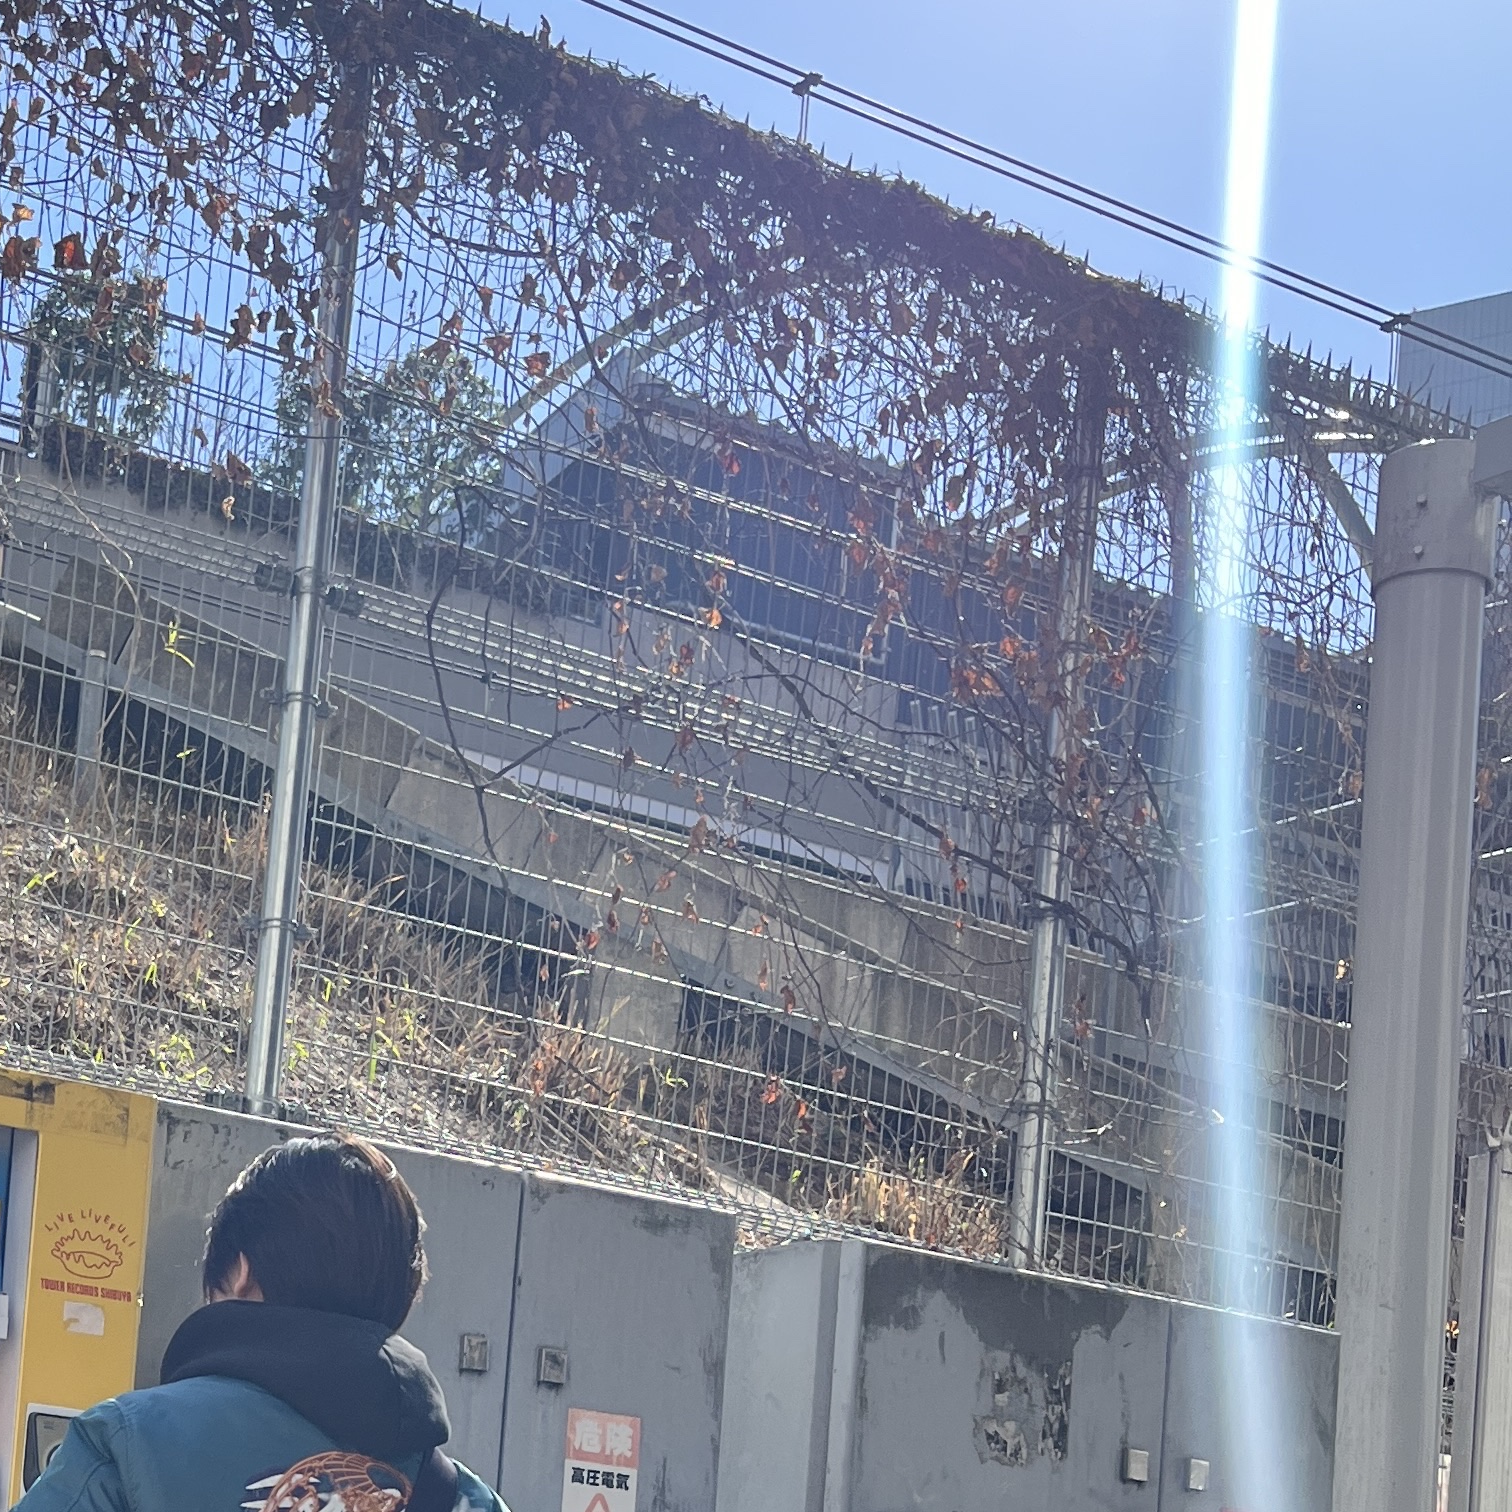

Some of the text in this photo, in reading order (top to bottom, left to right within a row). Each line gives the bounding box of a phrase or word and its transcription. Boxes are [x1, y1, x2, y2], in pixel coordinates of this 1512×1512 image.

[40, 1277, 65, 1292] TOWER
[573, 1418, 634, 1458] 危険
[571, 1466, 630, 1491] 高圧電気
